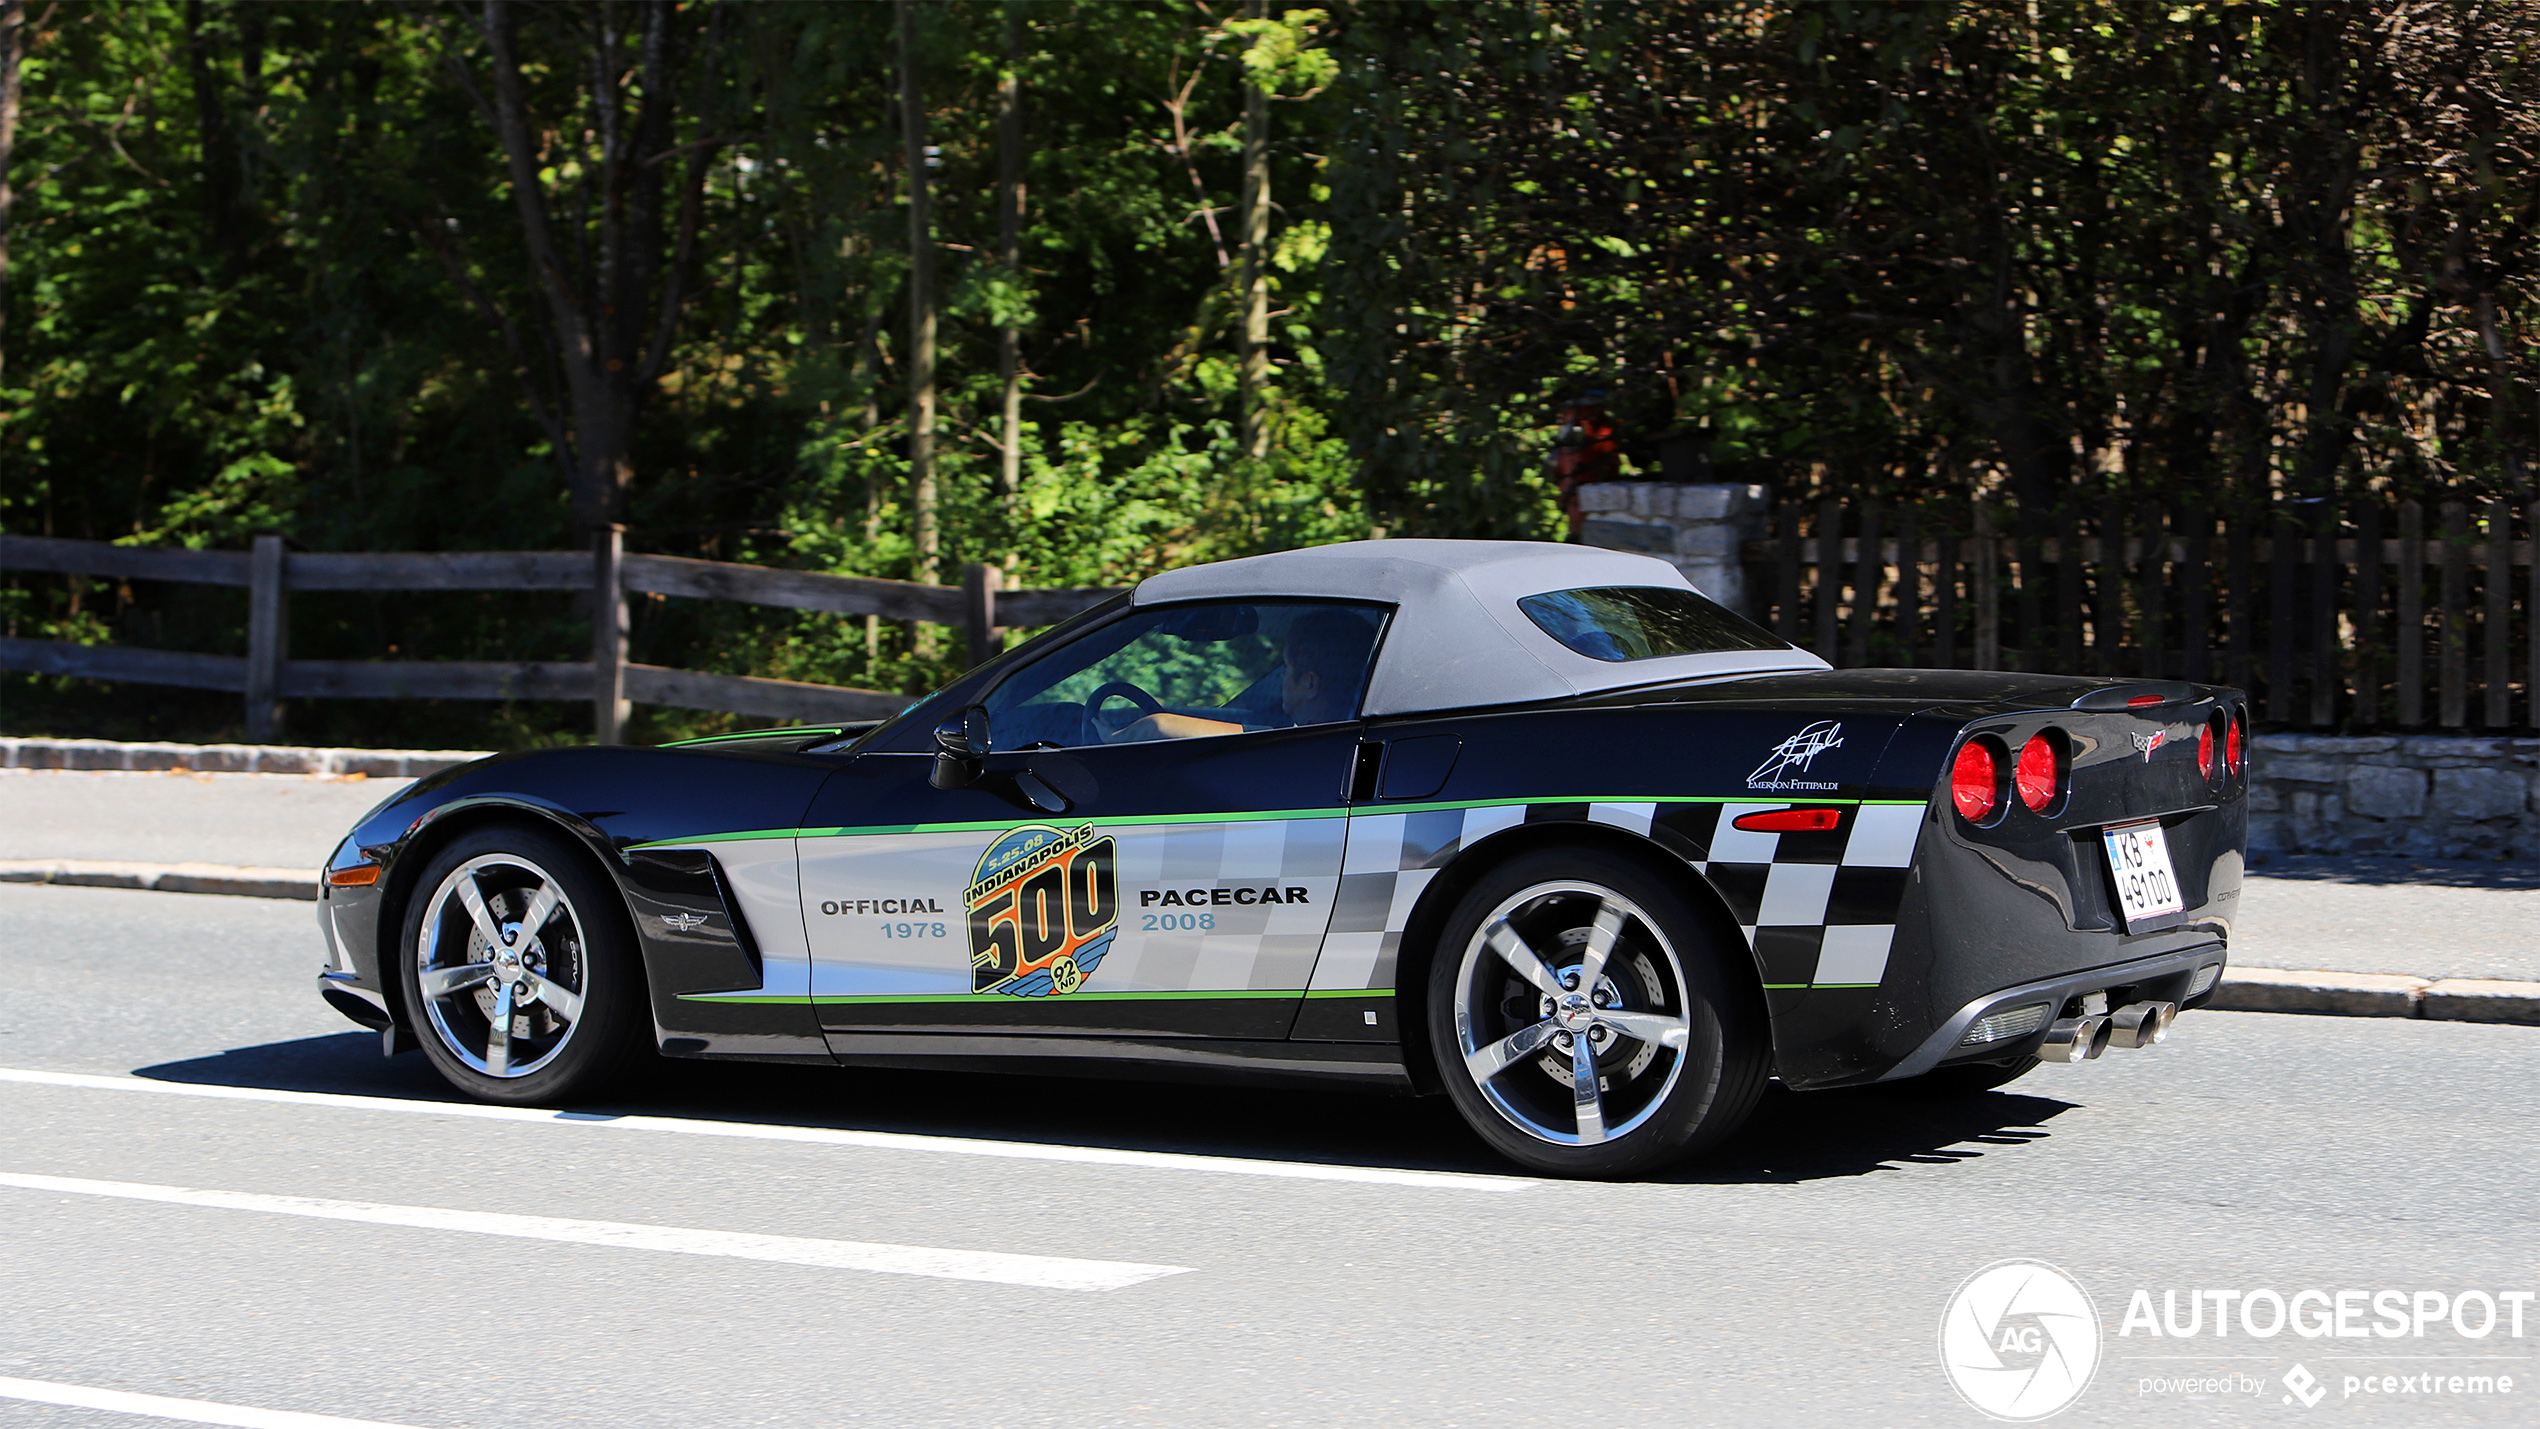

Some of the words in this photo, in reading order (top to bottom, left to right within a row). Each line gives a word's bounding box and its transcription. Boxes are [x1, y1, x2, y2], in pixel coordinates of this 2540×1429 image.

[1747, 780, 1791, 790] EMERSON
[1791, 779, 1838, 790] FITTIPALDI
[988, 834, 1044, 872] 5.25.08
[2120, 832, 2142, 869] KB
[965, 824, 1093, 903] INDIANAPOLIS
[821, 898, 944, 915] OFFICIAL
[1140, 886, 1310, 907] PACECAR
[967, 836, 1118, 994] 500
[1141, 913, 1216, 931] 2008
[880, 922, 946, 938] 1978
[1054, 959, 1077, 983] 92
[1060, 975, 1076, 990] ND
